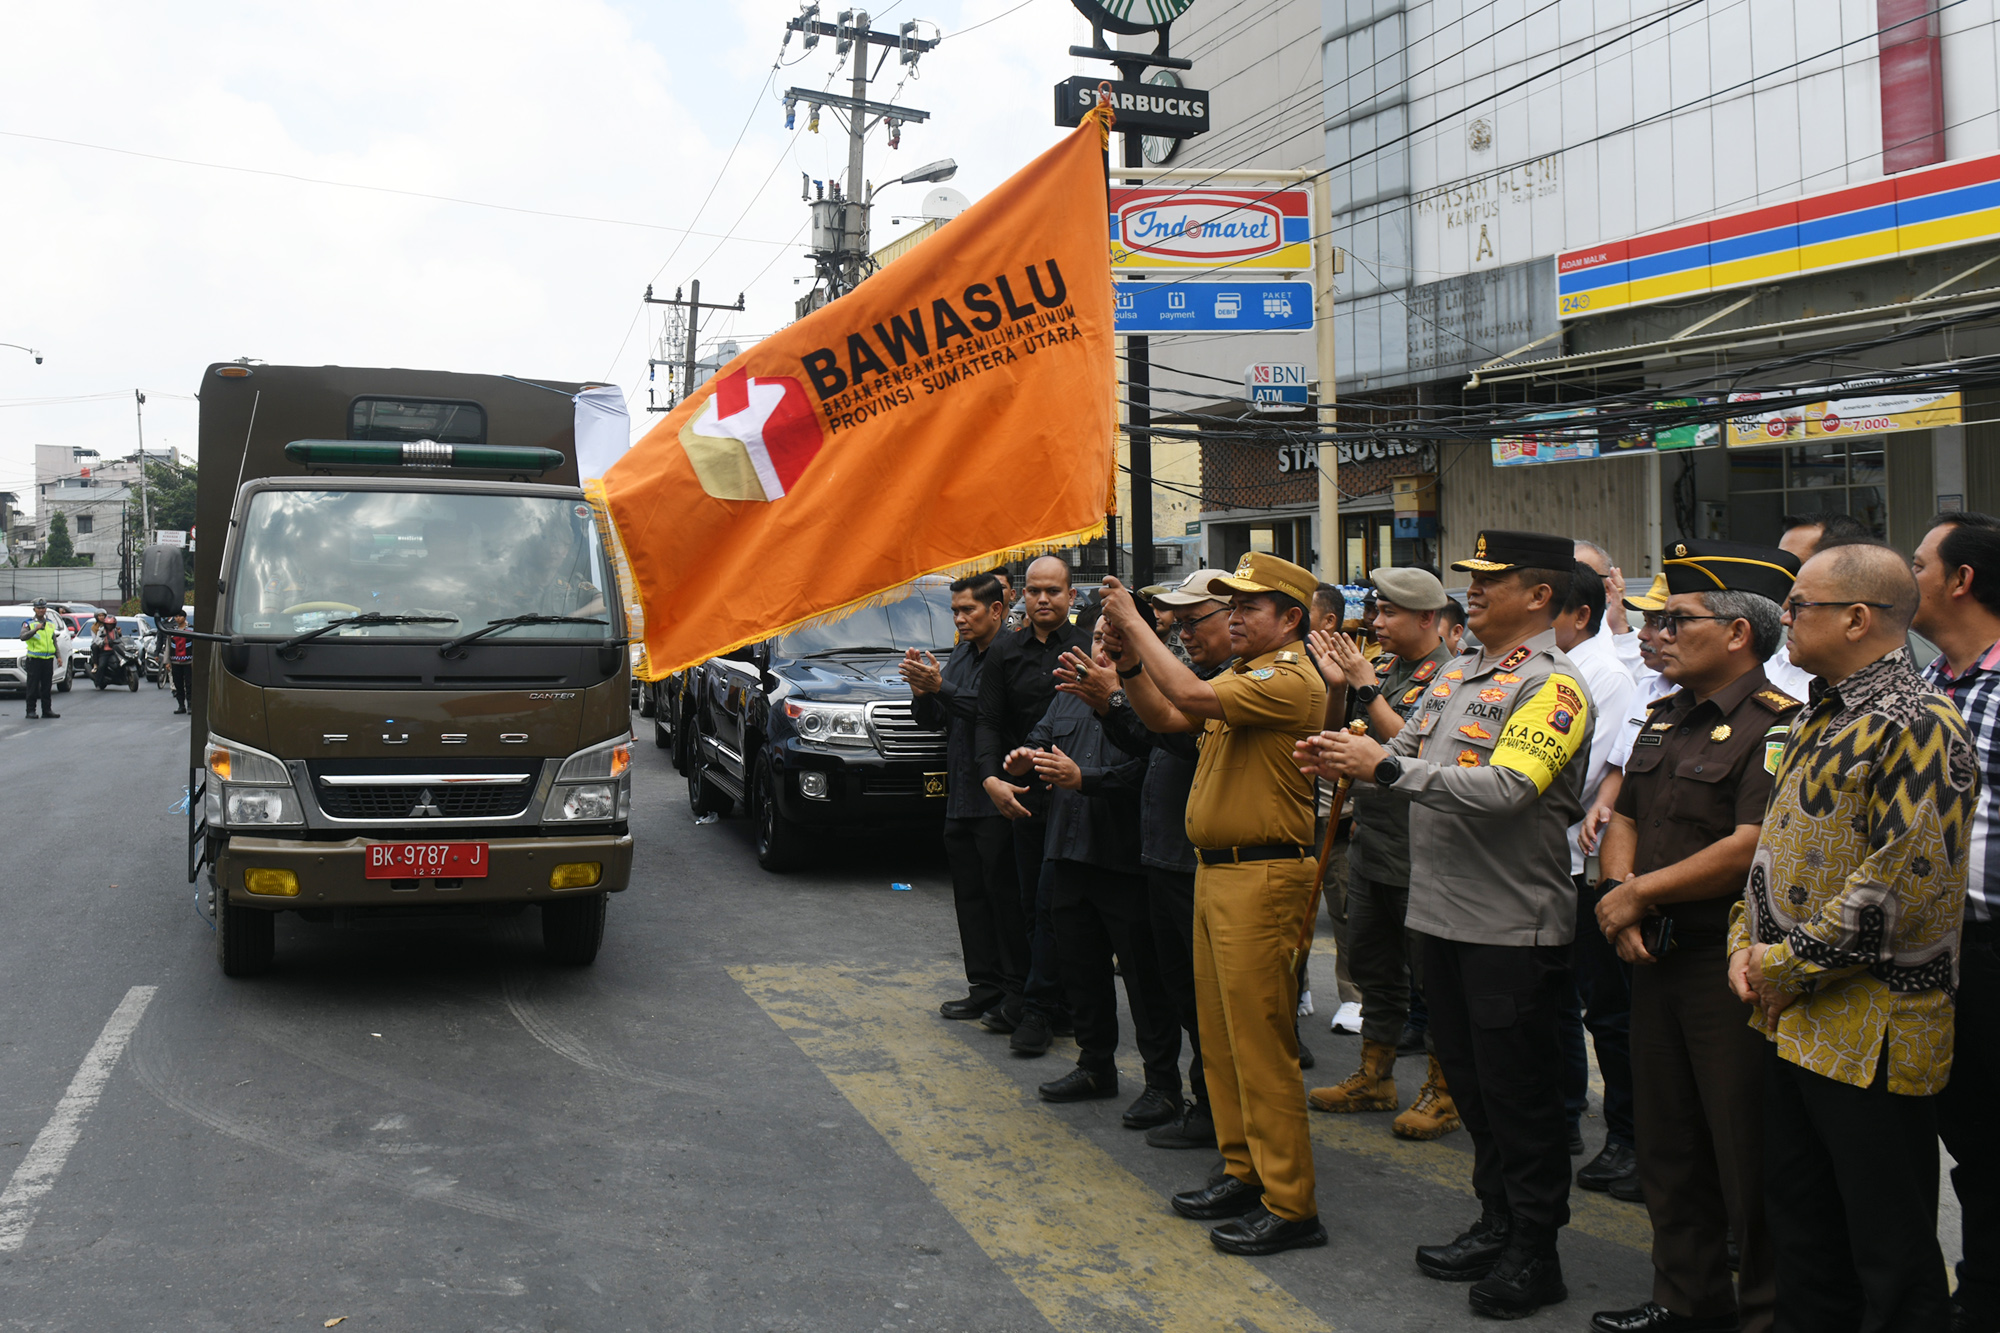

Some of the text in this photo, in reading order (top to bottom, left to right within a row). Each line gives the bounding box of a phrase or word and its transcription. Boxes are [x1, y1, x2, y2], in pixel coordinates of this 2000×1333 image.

[1134, 211, 1270, 239] Indomaret
[1475, 223, 1494, 262] A
[1561, 253, 1608, 270] ADAM MALIK
[1160, 311, 1195, 320] payment
[801, 258, 1067, 402] BAWASLU
[823, 304, 1077, 416] BADAN PENGAWAS PEMILIHAN UMUM
[829, 323, 1083, 435] PROVINSI SUMATERA UTARA
[1273, 366, 1305, 383] BNI
[1255, 389, 1283, 402] ATM
[1768, 425, 1784, 433] ICE
[1853, 417, 1889, 432] 7.000
[529, 692, 576, 700] CANTER
[1465, 703, 1503, 721] POLRI
[323, 733, 529, 745] FUSO
[373, 845, 480, 866] BK 9787 J
